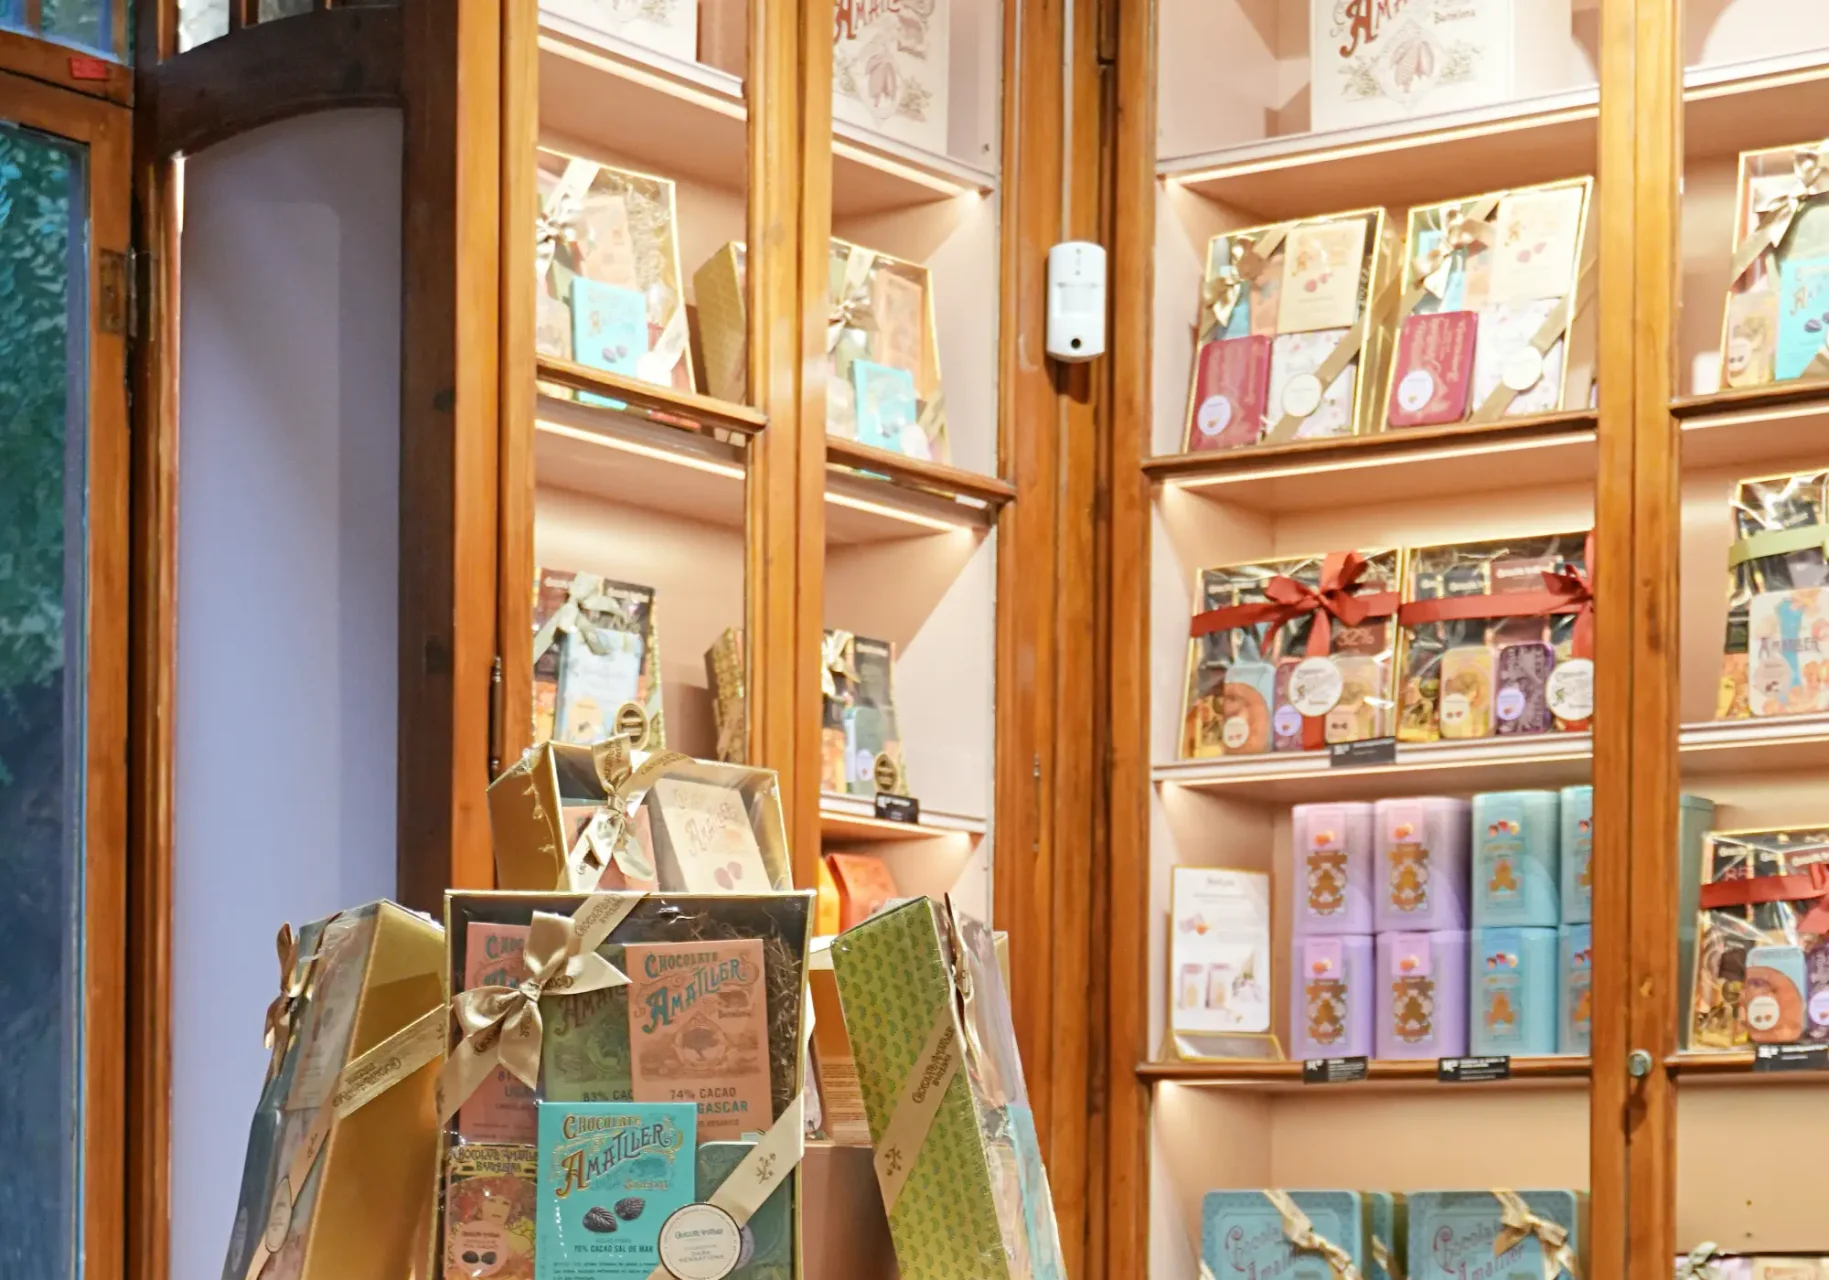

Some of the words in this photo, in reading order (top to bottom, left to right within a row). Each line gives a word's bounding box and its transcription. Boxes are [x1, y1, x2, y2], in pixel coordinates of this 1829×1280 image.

[645, 951, 728, 978] CHOCOLATE
[642, 958, 746, 1034] AMATLLER
[612, 1089, 634, 1101] CAC
[670, 1088, 695, 1100] 74%
[699, 1087, 737, 1099] CACAO
[697, 1101, 748, 1114] GASCAR
[562, 1114, 643, 1140] CHOCOLATE
[556, 1124, 672, 1199] AMATLLER
